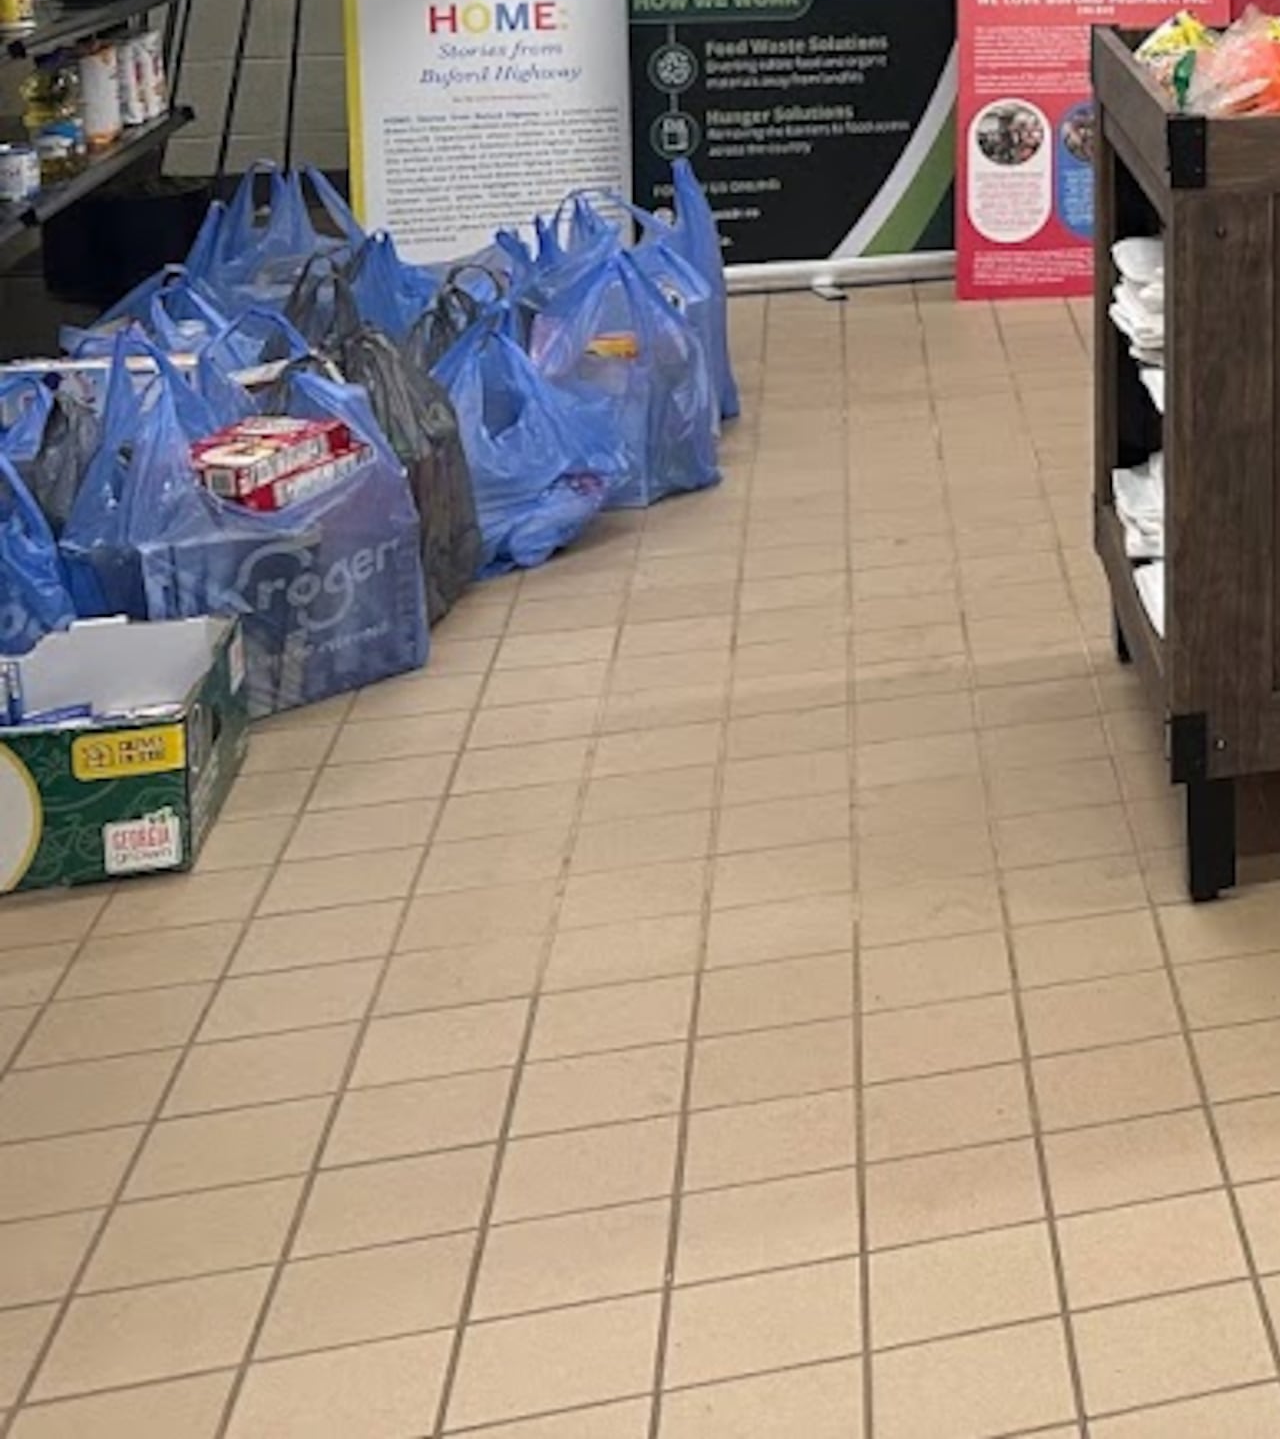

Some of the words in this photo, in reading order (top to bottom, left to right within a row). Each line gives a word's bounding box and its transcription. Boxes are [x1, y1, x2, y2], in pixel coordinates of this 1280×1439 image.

[429, 1, 568, 34] HOME:
[438, 43, 506, 60] Stories
[510, 41, 563, 60] from
[706, 38, 749, 56] Food
[750, 37, 805, 55] Waste
[808, 34, 889, 52] Solutions
[420, 67, 489, 89] Buford
[495, 65, 583, 84] Highway
[706, 109, 771, 127] Hunger
[773, 105, 855, 123] Solutions
